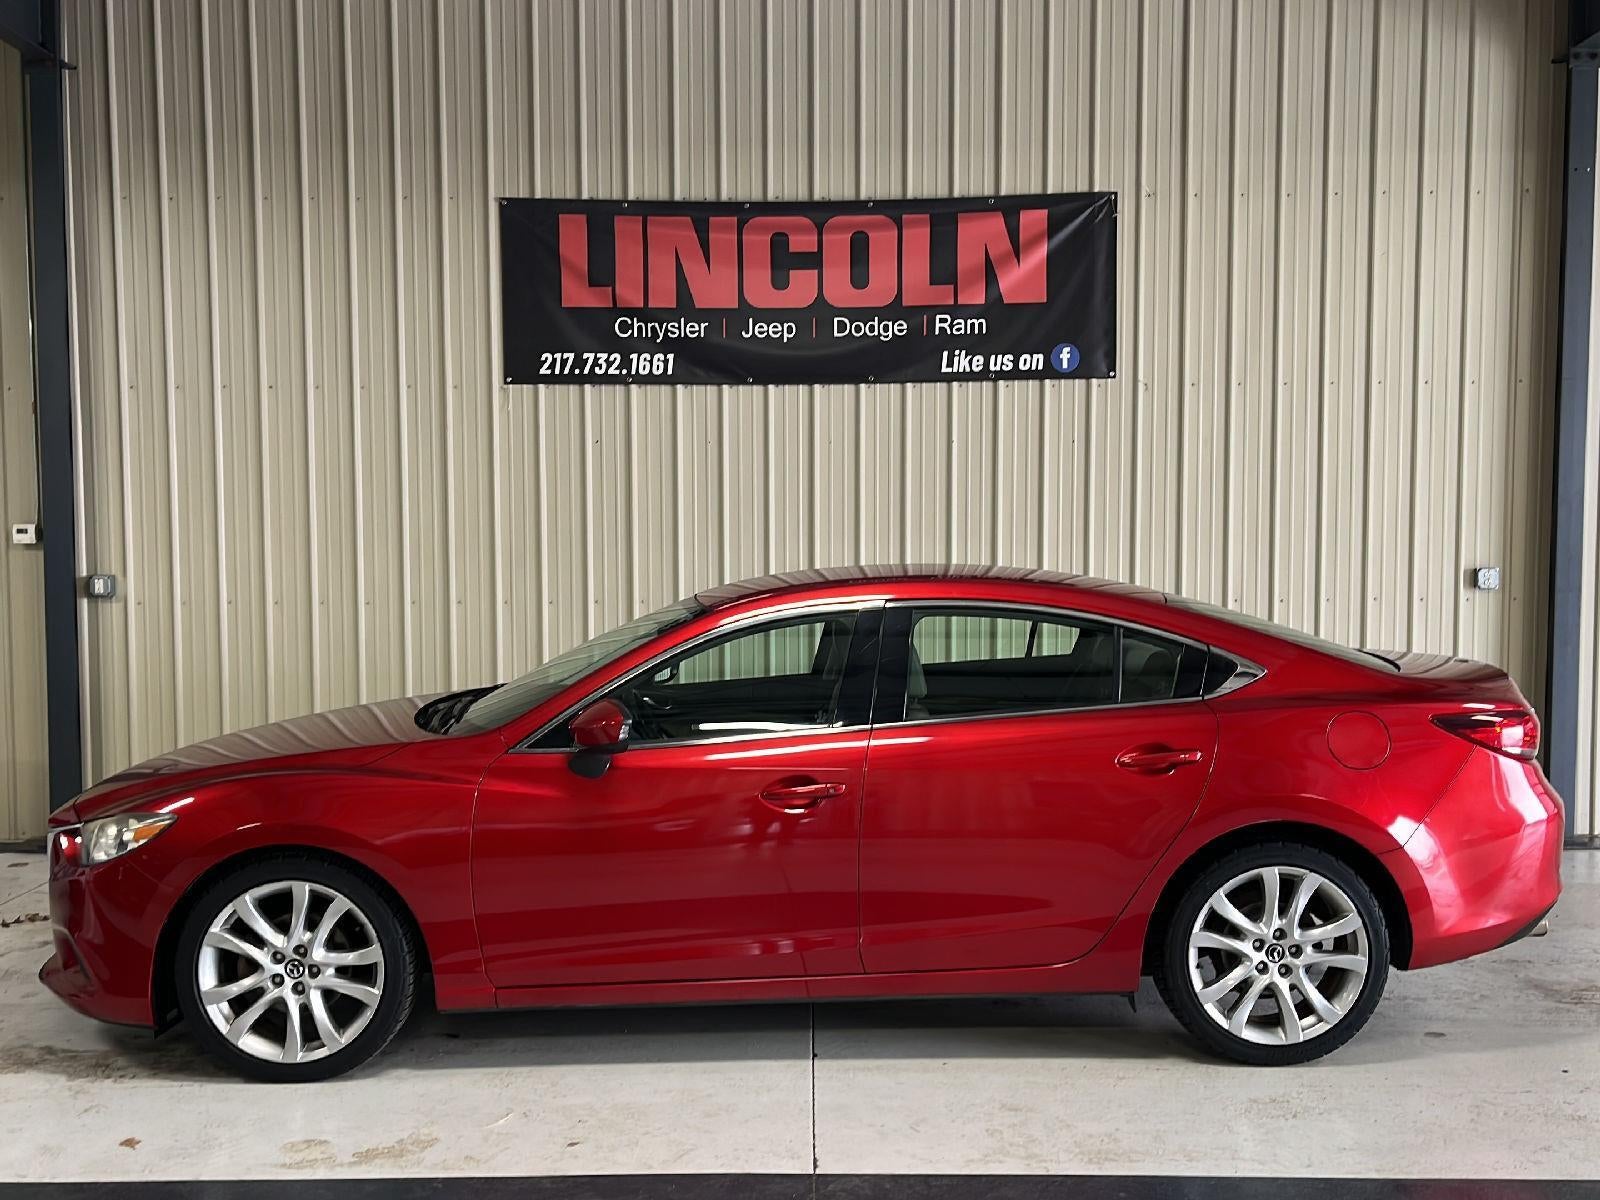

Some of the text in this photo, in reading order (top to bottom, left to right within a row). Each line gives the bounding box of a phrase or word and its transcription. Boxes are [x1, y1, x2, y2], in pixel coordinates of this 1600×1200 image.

[558, 208, 1049, 309] LINCOLN
[614, 314, 987, 342] Chrysler Jeep Dodge Ram
[539, 352, 675, 375] 217.732.1661
[940, 350, 984, 373] Like
[989, 352, 1014, 372] us
[1018, 352, 1044, 371] on
